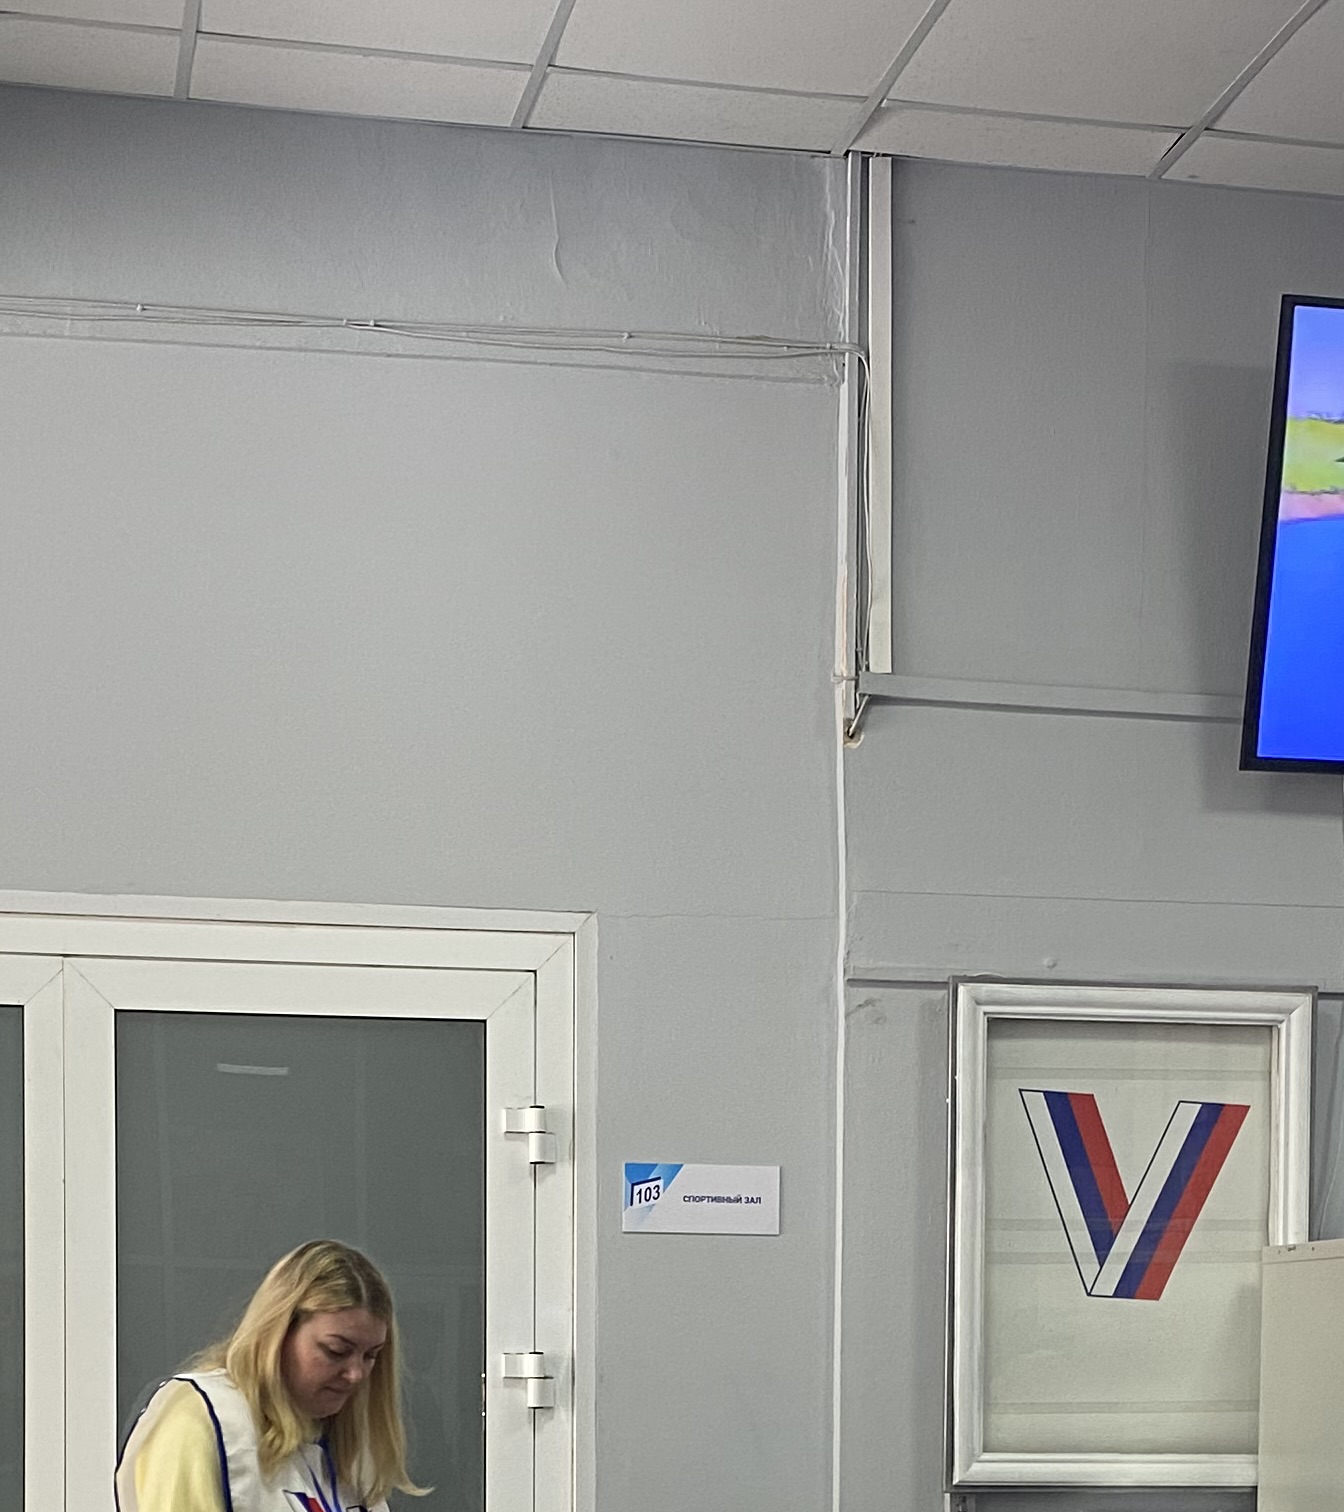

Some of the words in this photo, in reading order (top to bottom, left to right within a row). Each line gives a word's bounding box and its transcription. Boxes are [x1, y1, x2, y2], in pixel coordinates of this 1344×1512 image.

[635, 1184, 661, 1204] 103
[682, 1194, 743, 1204] СПОРТИВНЫЙ
[744, 1196, 762, 1204] ЗАЛ
